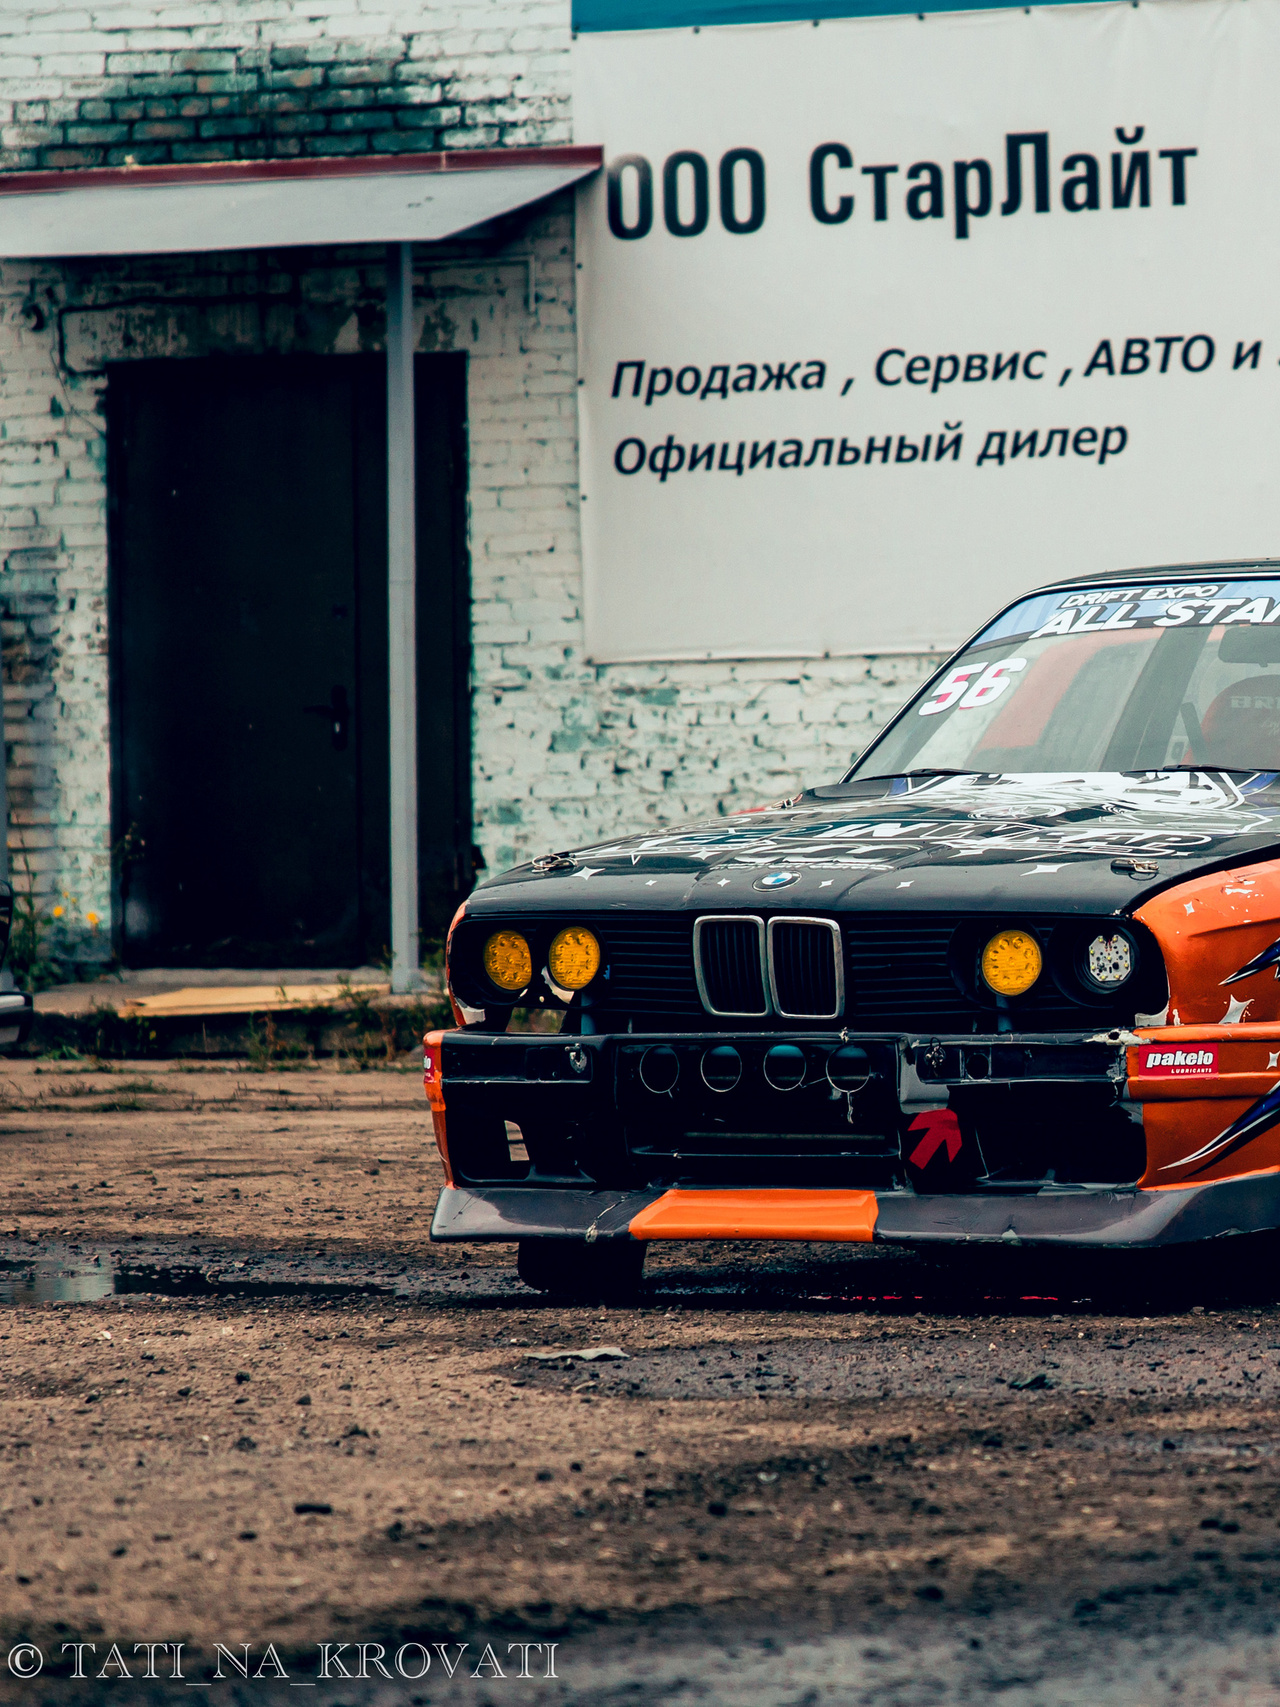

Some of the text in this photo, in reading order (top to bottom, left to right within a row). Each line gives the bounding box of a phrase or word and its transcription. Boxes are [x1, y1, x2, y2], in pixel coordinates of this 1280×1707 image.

[607, 126, 1198, 239] ООО СтарЛайт
[610, 359, 827, 405] Продажа
[874, 348, 1047, 393] Сервис
[1083, 334, 1215, 378] АВТО
[1232, 340, 1262, 370] и
[613, 421, 1129, 482] Официальный дилер
[1028, 602, 1138, 639] ALL
[1061, 585, 1219, 609] DRIFT EXPO
[918, 657, 1027, 717] 56
[1145, 1050, 1214, 1068] pakelo
